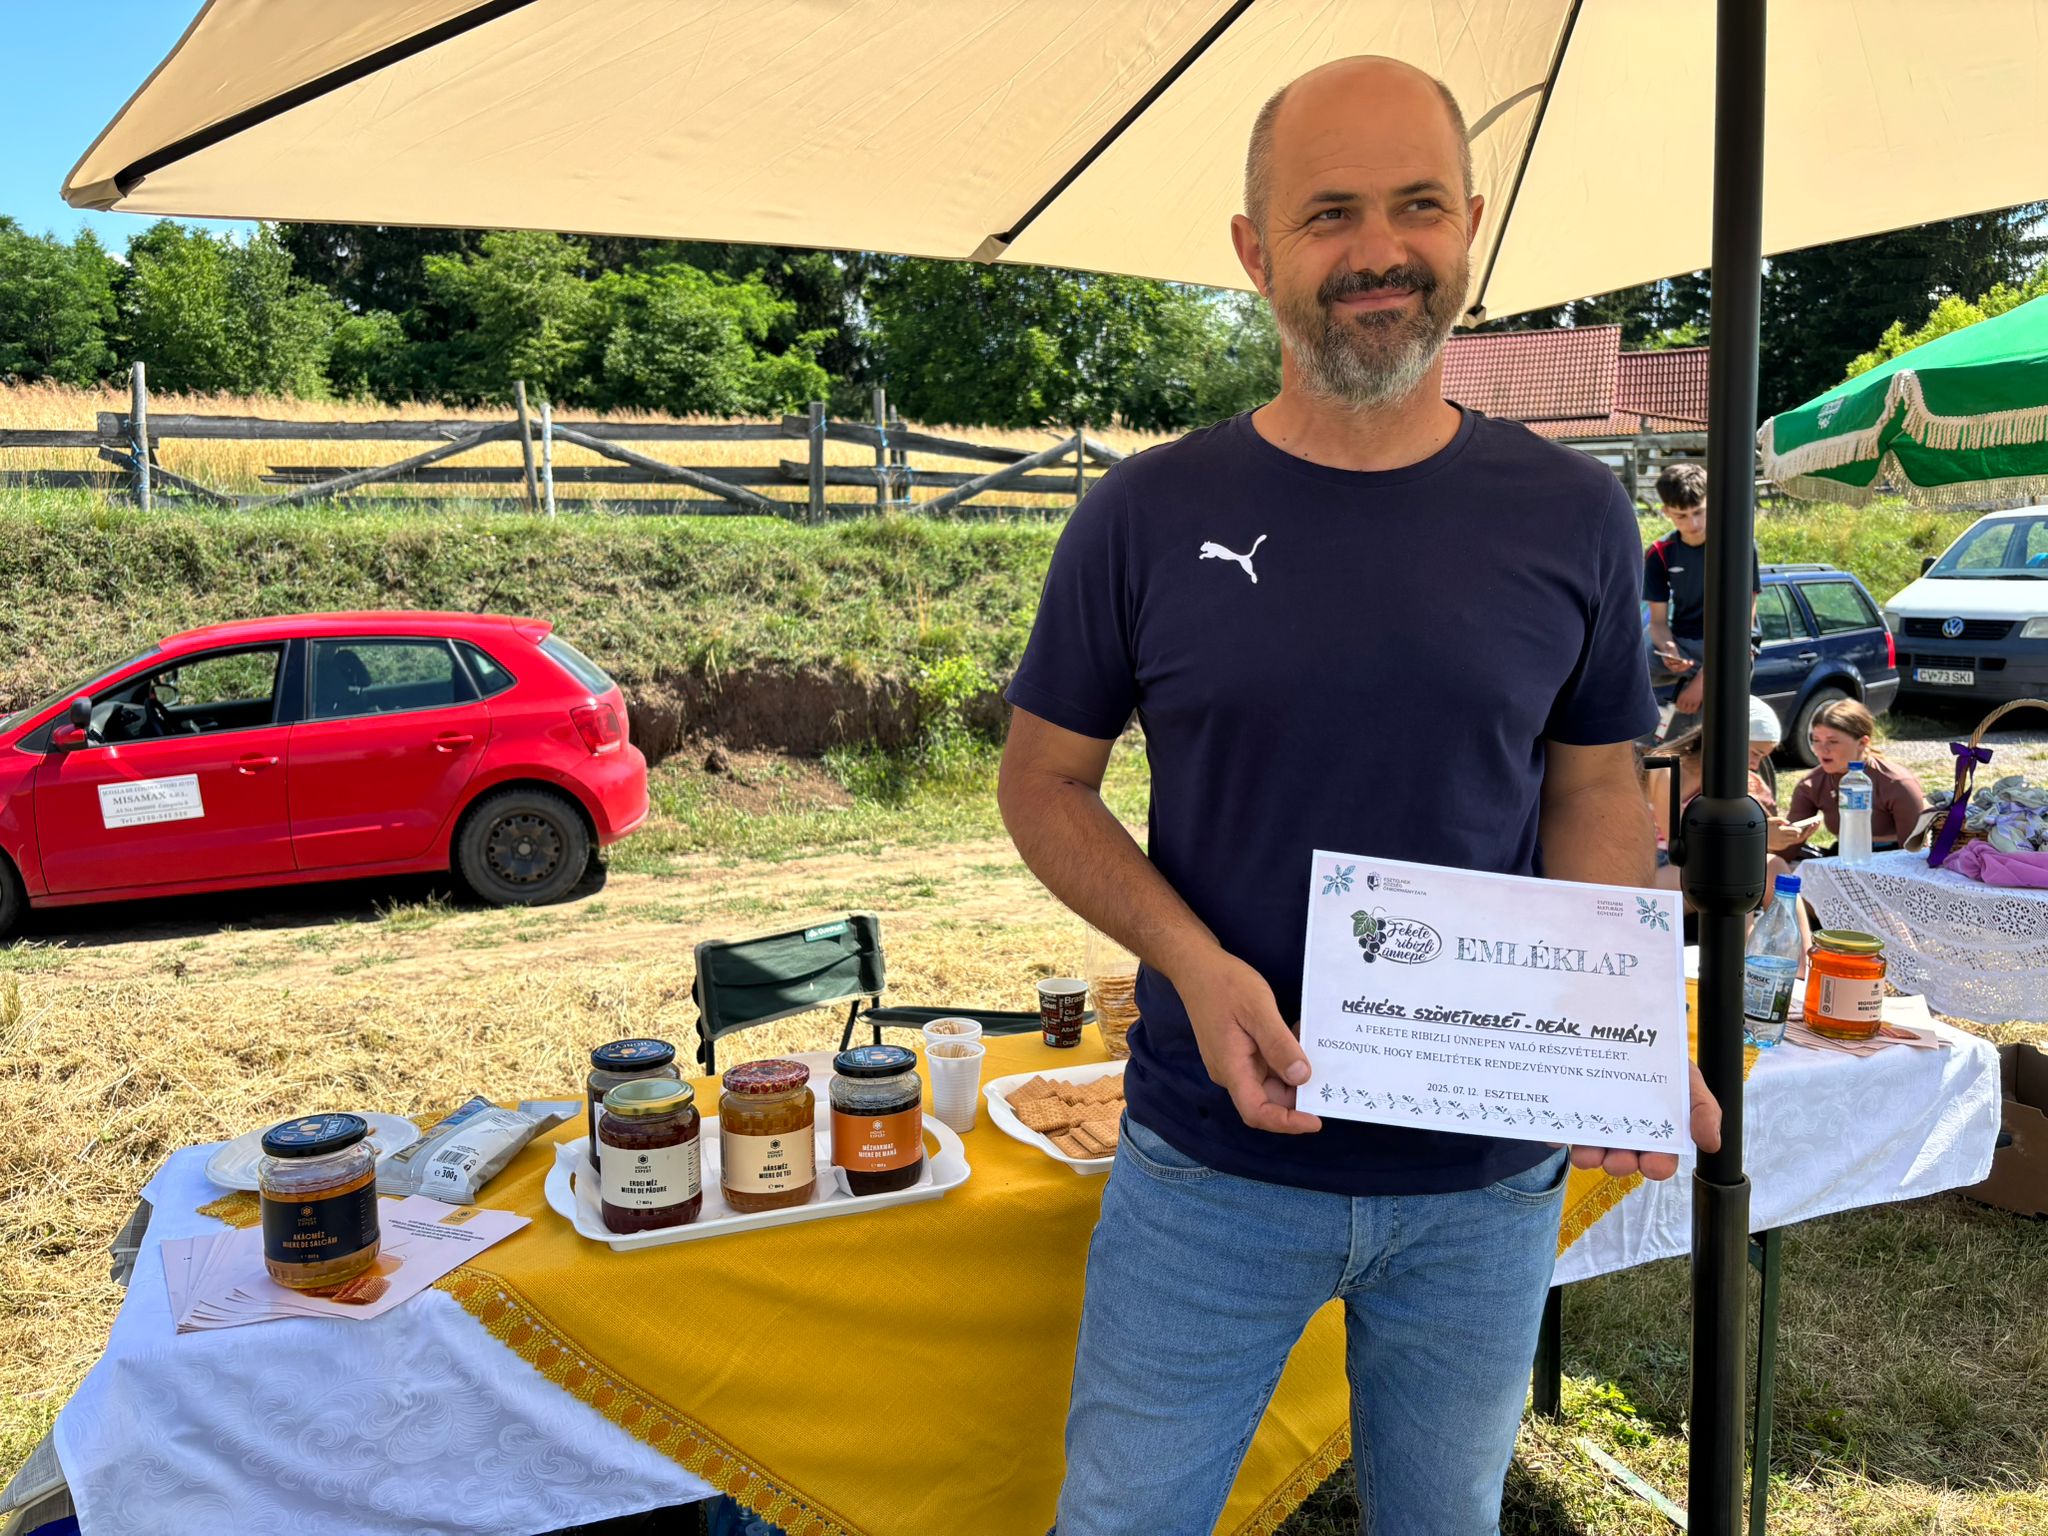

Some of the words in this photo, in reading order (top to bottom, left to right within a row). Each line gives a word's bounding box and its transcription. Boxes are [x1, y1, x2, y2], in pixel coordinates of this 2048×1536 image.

[1919, 670, 1933, 680] CV
[1938, 672, 1950, 681] 73
[1952, 672, 1971, 683] SKI
[113, 791, 166, 806] MISAMAX
[1386, 920, 1431, 940] Fekete
[1394, 937, 1435, 954] ribizli
[1454, 936, 1639, 977] EMLÉKLAP
[1342, 995, 1407, 1018] MÉHÉSZ
[1590, 1023, 1658, 1048] MIHÁLY
[1356, 1024, 1363, 1032] A
[1366, 1024, 1408, 1038] FEKETE
[1411, 1030, 1450, 1044] RIBIZLI
[1508, 1041, 1536, 1052] VALÓ
[1539, 1043, 1630, 1061] RÉSZVÉTELÉRT.
[1384, 1046, 1413, 1058] HOGY
[1416, 1050, 1482, 1066] EMELTÉTEK
[1586, 1068, 1668, 1084] SZÍNVONALÁT!
[1427, 1082, 1450, 1094] 2025.
[1484, 1088, 1550, 1104] ESZTELNEK
